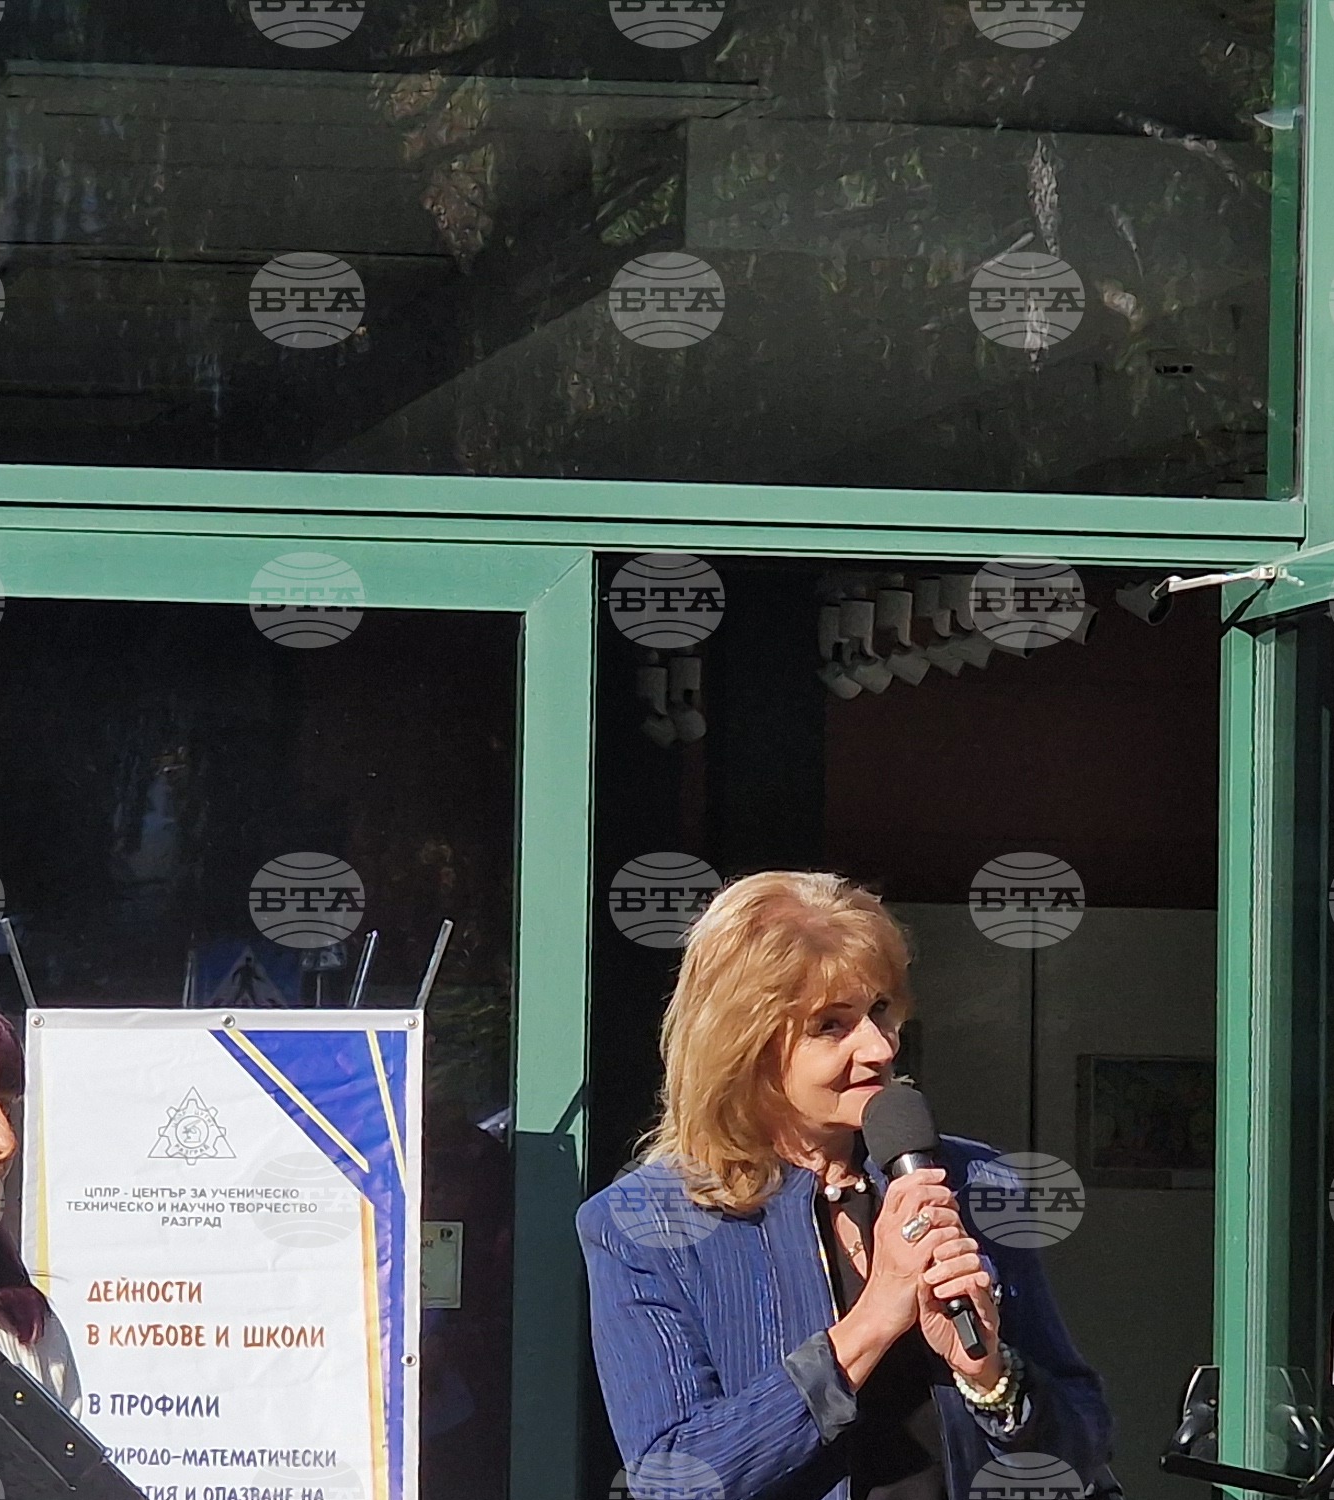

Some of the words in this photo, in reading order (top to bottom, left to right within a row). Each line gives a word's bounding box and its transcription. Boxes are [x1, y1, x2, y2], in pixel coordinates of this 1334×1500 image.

[85, 1188, 120, 1198] ЦПЛР
[132, 1188, 186, 1199] ЦЕНТЪР
[191, 1188, 207, 1198] ЗА
[211, 1188, 299, 1199] УЧЕНИЧЕСКО
[67, 1201, 154, 1212] ТЕХНИЧЕСКО
[158, 1202, 167, 1212] И
[171, 1202, 225, 1213] НАУЧНО
[230, 1202, 317, 1213] ТВОРЧЕСТВО
[161, 1216, 222, 1228] РАЗГРАД
[87, 1277, 202, 1303] ДЕЙНОСТИ
[87, 1324, 100, 1345] В
[110, 1324, 206, 1347] КЛУБОВЕ
[216, 1326, 229, 1347] И
[244, 1325, 324, 1348] ШКОЛИ
[88, 1393, 101, 1415] В
[111, 1394, 220, 1417] ПРОФИЛИ
[103, 1447, 337, 1468] РИРОДО-МАТЕМАТИЧЕСКИ
